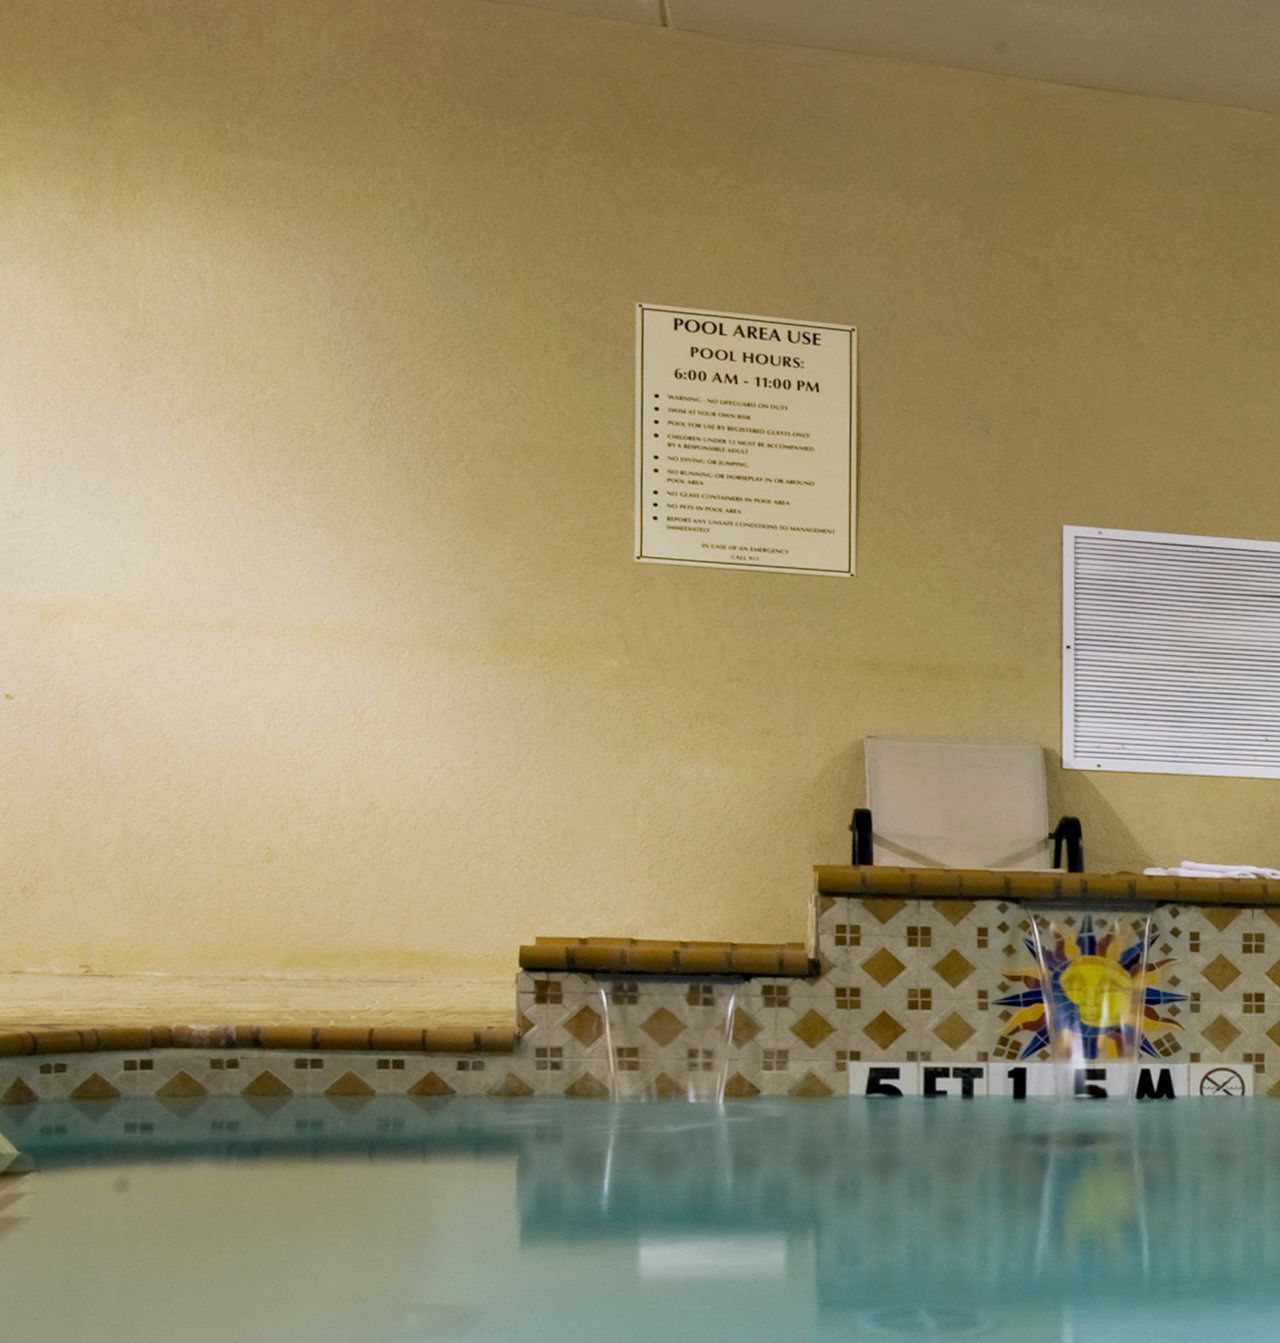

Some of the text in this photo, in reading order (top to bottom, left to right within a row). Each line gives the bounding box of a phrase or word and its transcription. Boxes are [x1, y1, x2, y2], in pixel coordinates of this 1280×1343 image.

[673, 318, 822, 346] POOL AREA USE
[690, 347, 805, 369] POOL HOURS:
[674, 368, 707, 381] 6:00
[712, 373, 738, 385] AM
[755, 377, 791, 390] 11:00
[796, 380, 820, 393] PM
[668, 394, 701, 403] WARNING
[720, 399, 756, 408] LIFEGUARD
[770, 403, 789, 411] DUTY
[667, 420, 686, 428] POOL
[727, 425, 765, 434] REGISTERED
[767, 428, 791, 436] GUESTS
[792, 430, 811, 438] ONLY
[667, 434, 701, 443] CHILDREN
[703, 436, 726, 444] UNDER
[683, 444, 725, 454] RESPONSIBLE
[727, 447, 749, 455] ADULT
[865, 1067, 904, 1097] 5
[923, 1067, 984, 1099] FT
[1007, 1067, 1027, 1099] 1
[1136, 1068, 1176, 1099] M
